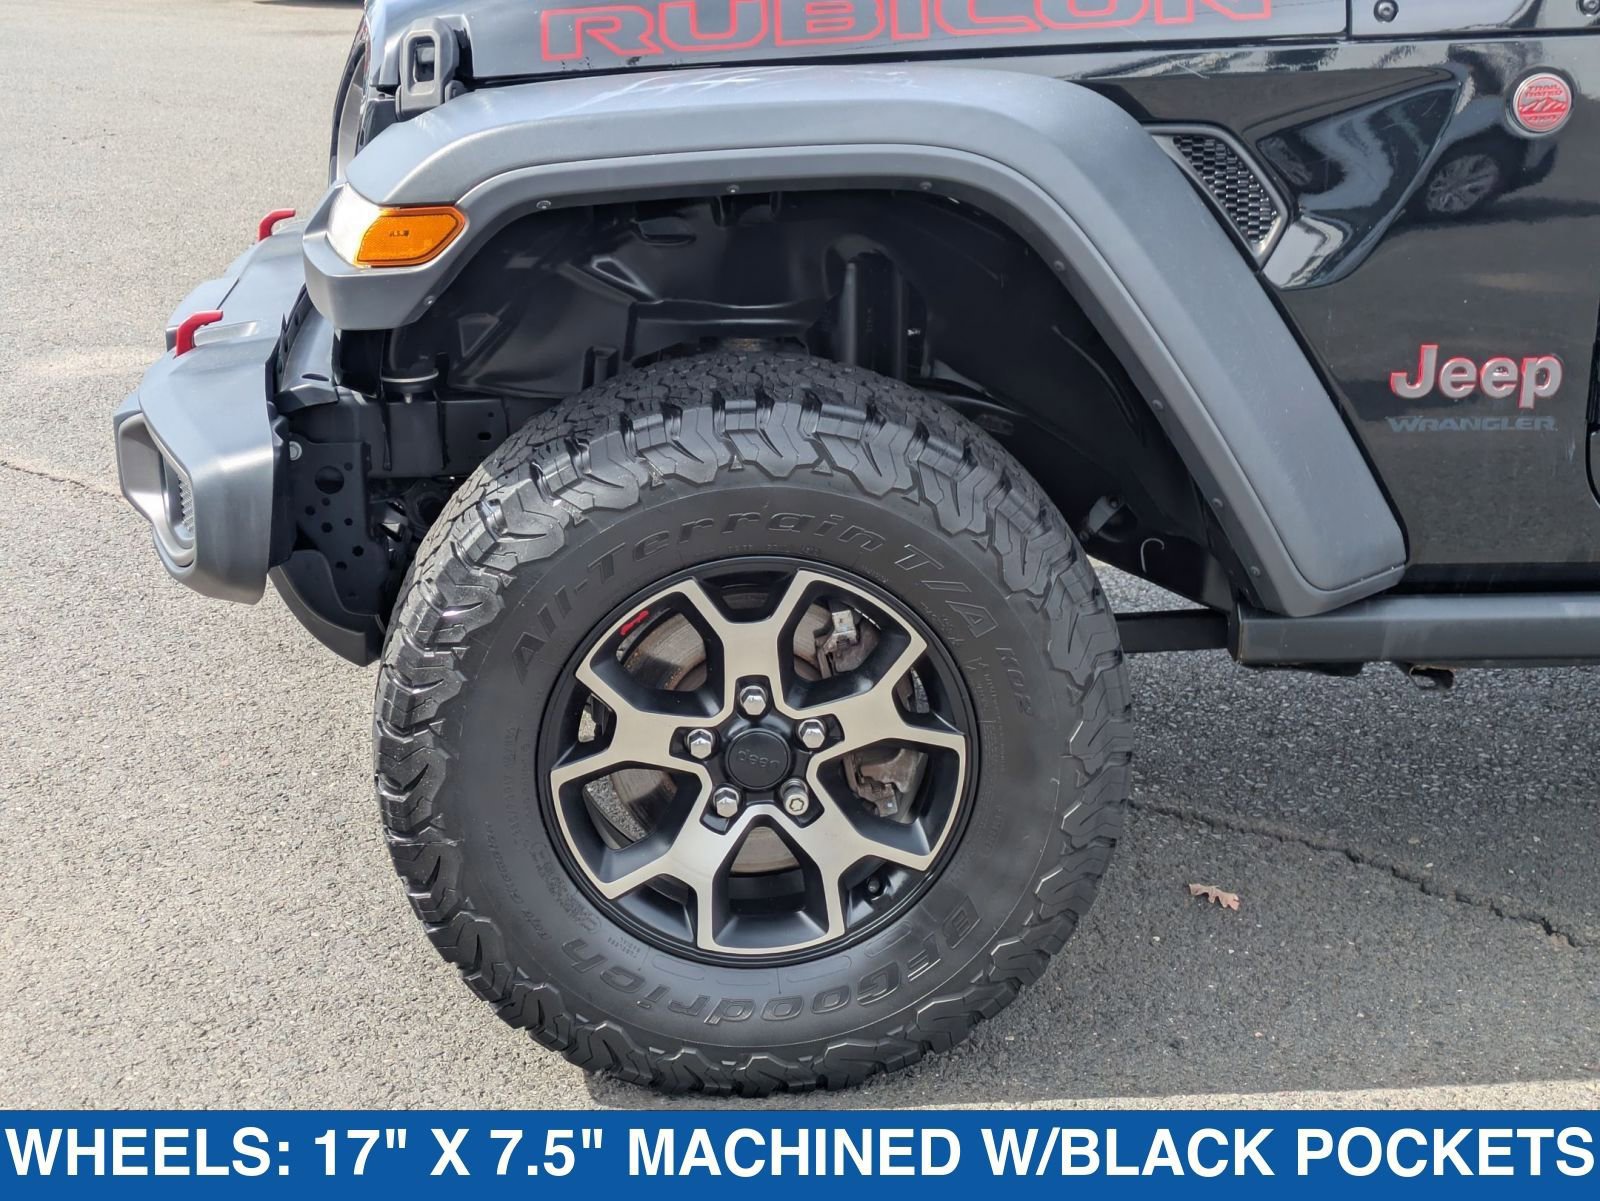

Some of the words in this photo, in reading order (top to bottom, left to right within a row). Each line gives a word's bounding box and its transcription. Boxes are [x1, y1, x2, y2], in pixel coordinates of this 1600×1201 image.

[1389, 343, 1563, 409] Jeep
[1385, 415, 1557, 433] WRANGLER
[511, 508, 887, 686] All-Terrain
[561, 903, 984, 1026] BFGoodrich
